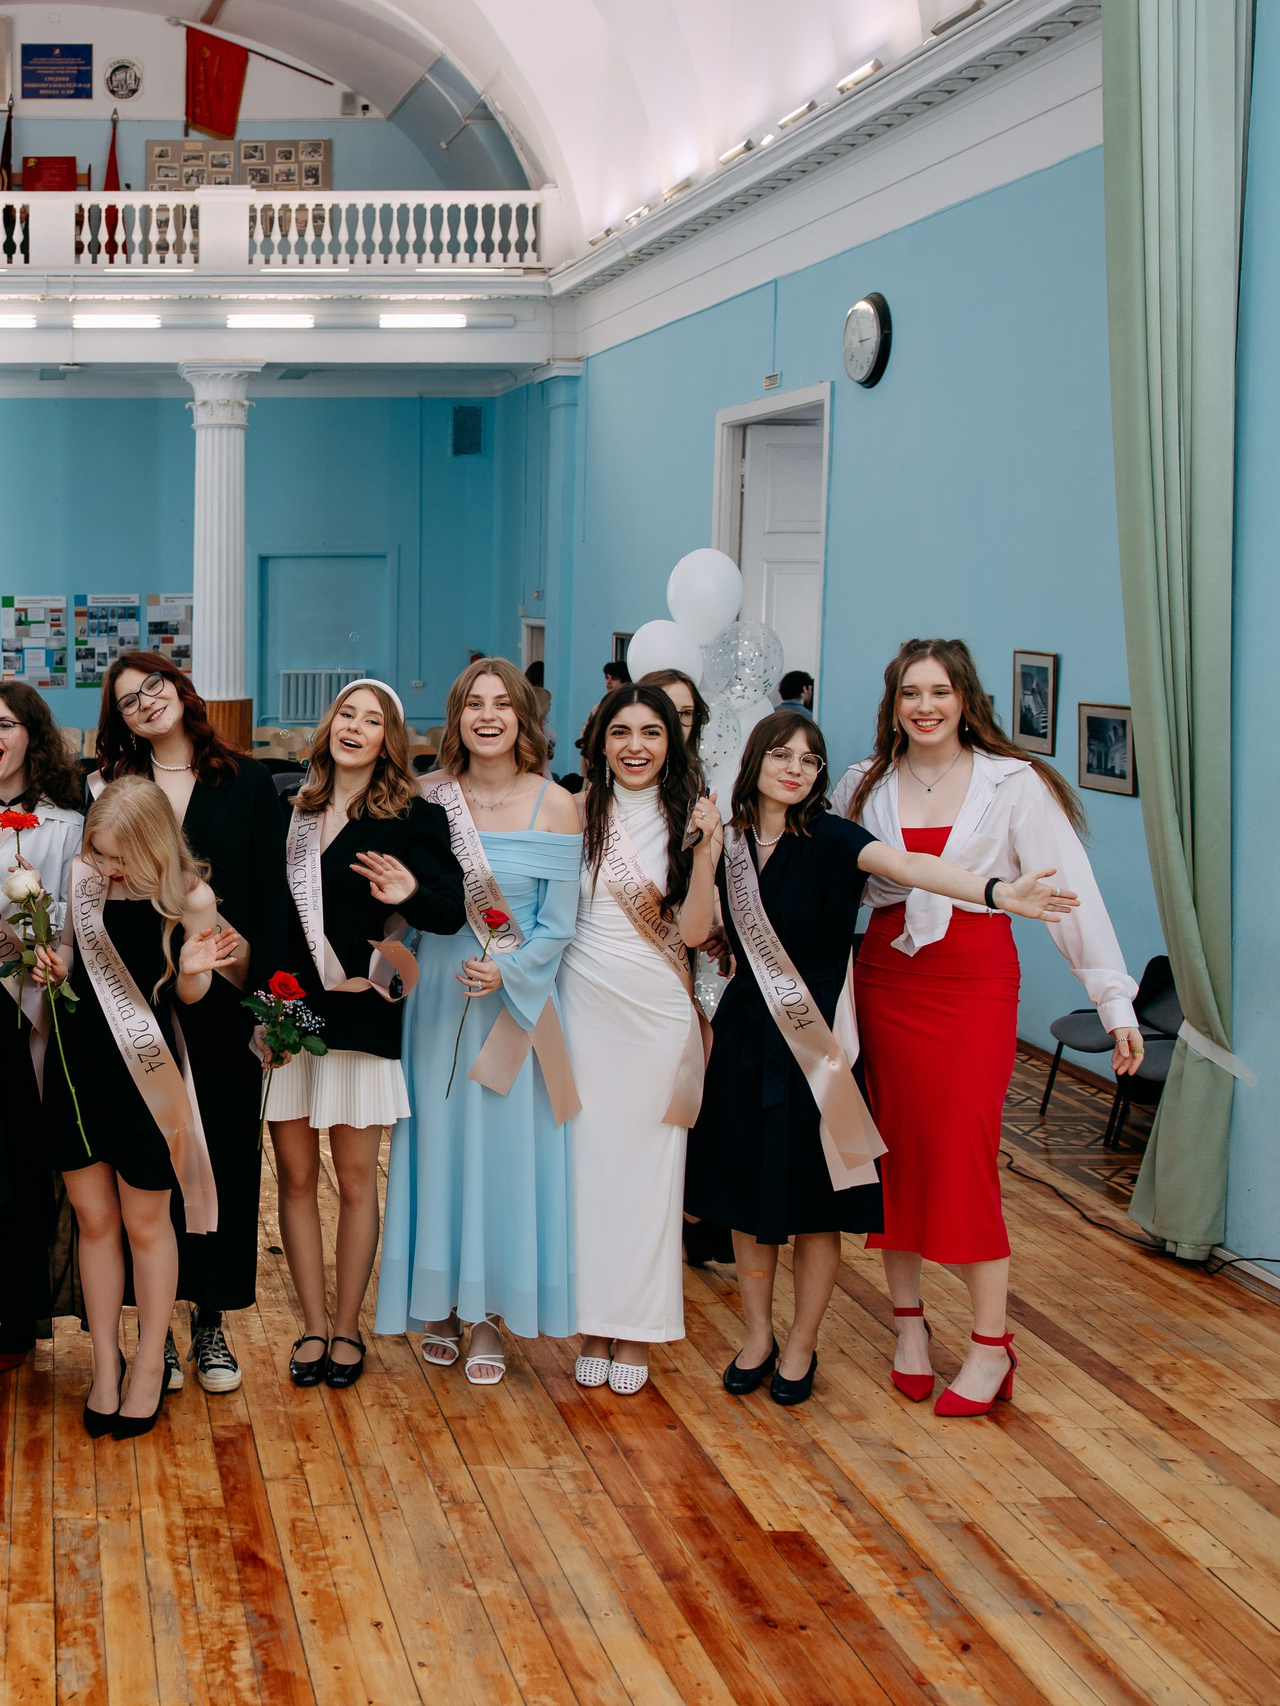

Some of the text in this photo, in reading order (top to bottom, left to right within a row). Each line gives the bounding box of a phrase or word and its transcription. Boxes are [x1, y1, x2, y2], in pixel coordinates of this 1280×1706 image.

[310, 848, 320, 911] Ермакова Дарья
[467, 827, 501, 902] Федоренко Ульяна
[629, 855, 648, 883] Туманян
[730, 859, 816, 1031] Выпускница 2024
[752, 889, 781, 953] Выставкина Яна
[80, 898, 167, 1075] Выпускница 2024
[99, 929, 133, 989] Петрова Нелли
[753, 953, 770, 991] «Покровский
[103, 996, 122, 1036] «Покровский
